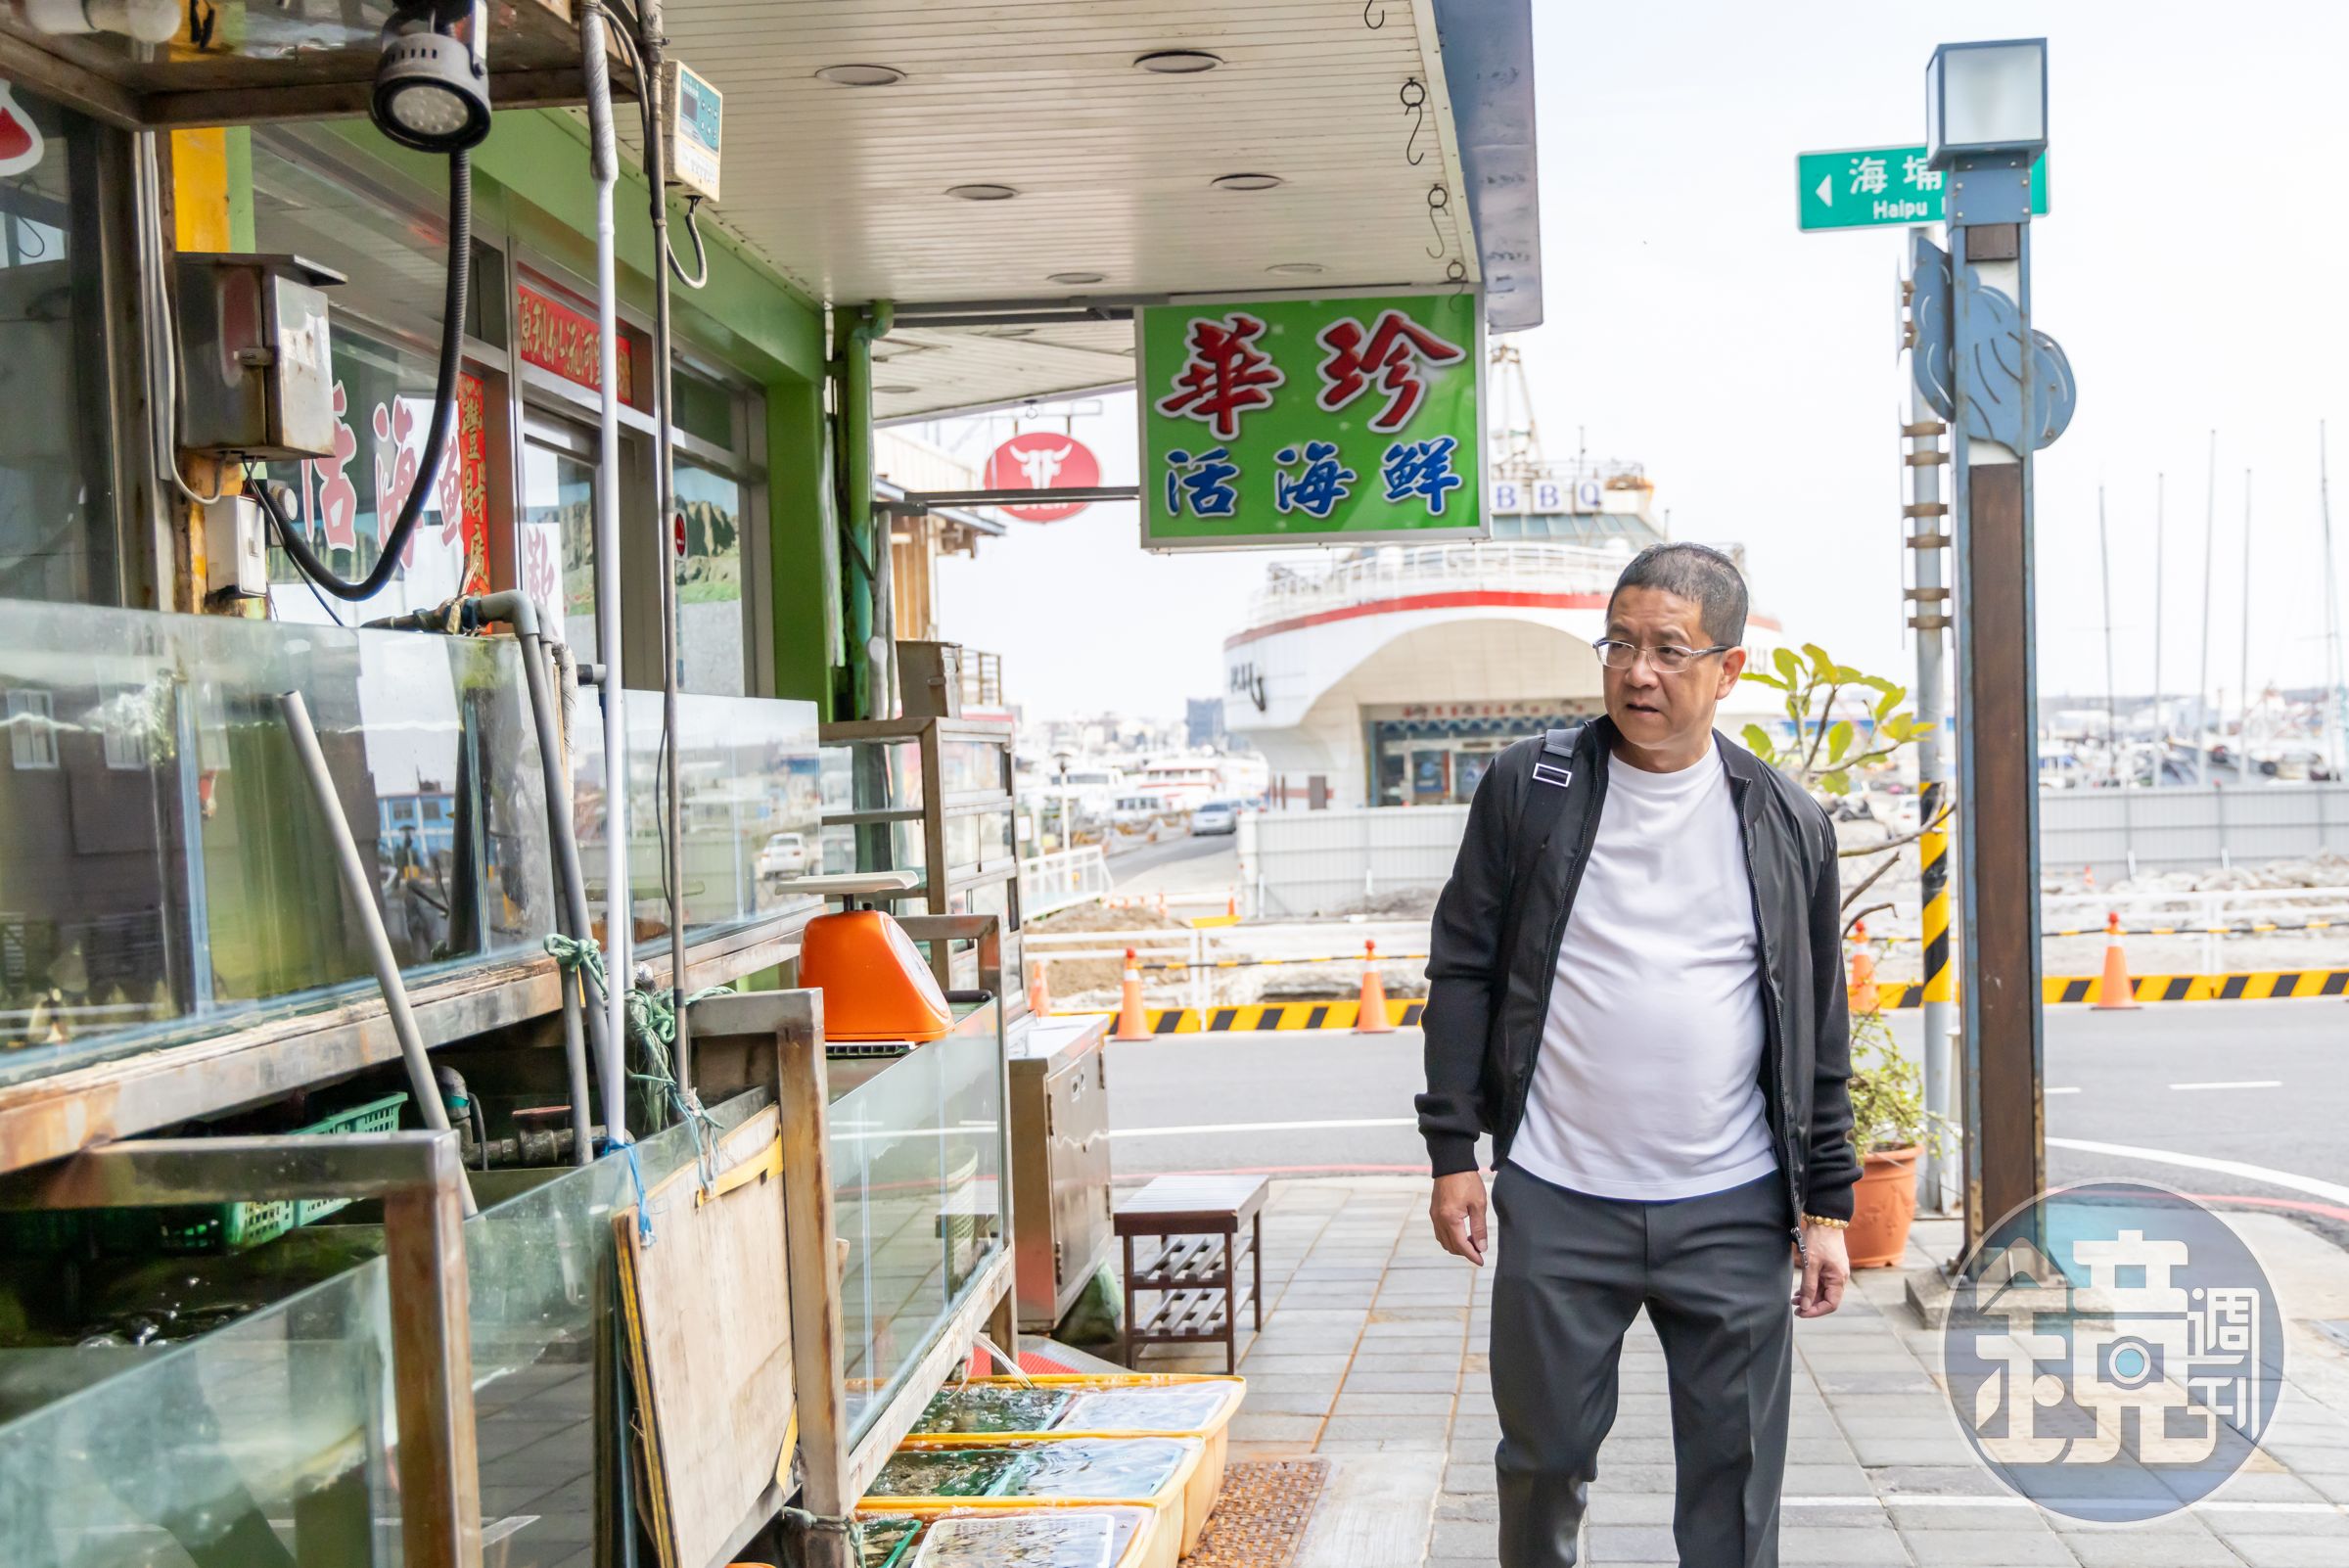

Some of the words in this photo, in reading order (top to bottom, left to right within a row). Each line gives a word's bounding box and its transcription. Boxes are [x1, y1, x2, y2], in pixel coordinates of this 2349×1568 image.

[1872, 200, 1928, 219] Haipu
[1156, 311, 1465, 438] 華珍
[1166, 437, 1461, 517] 活海鮮
[1497, 483, 1600, 508] BBQ
